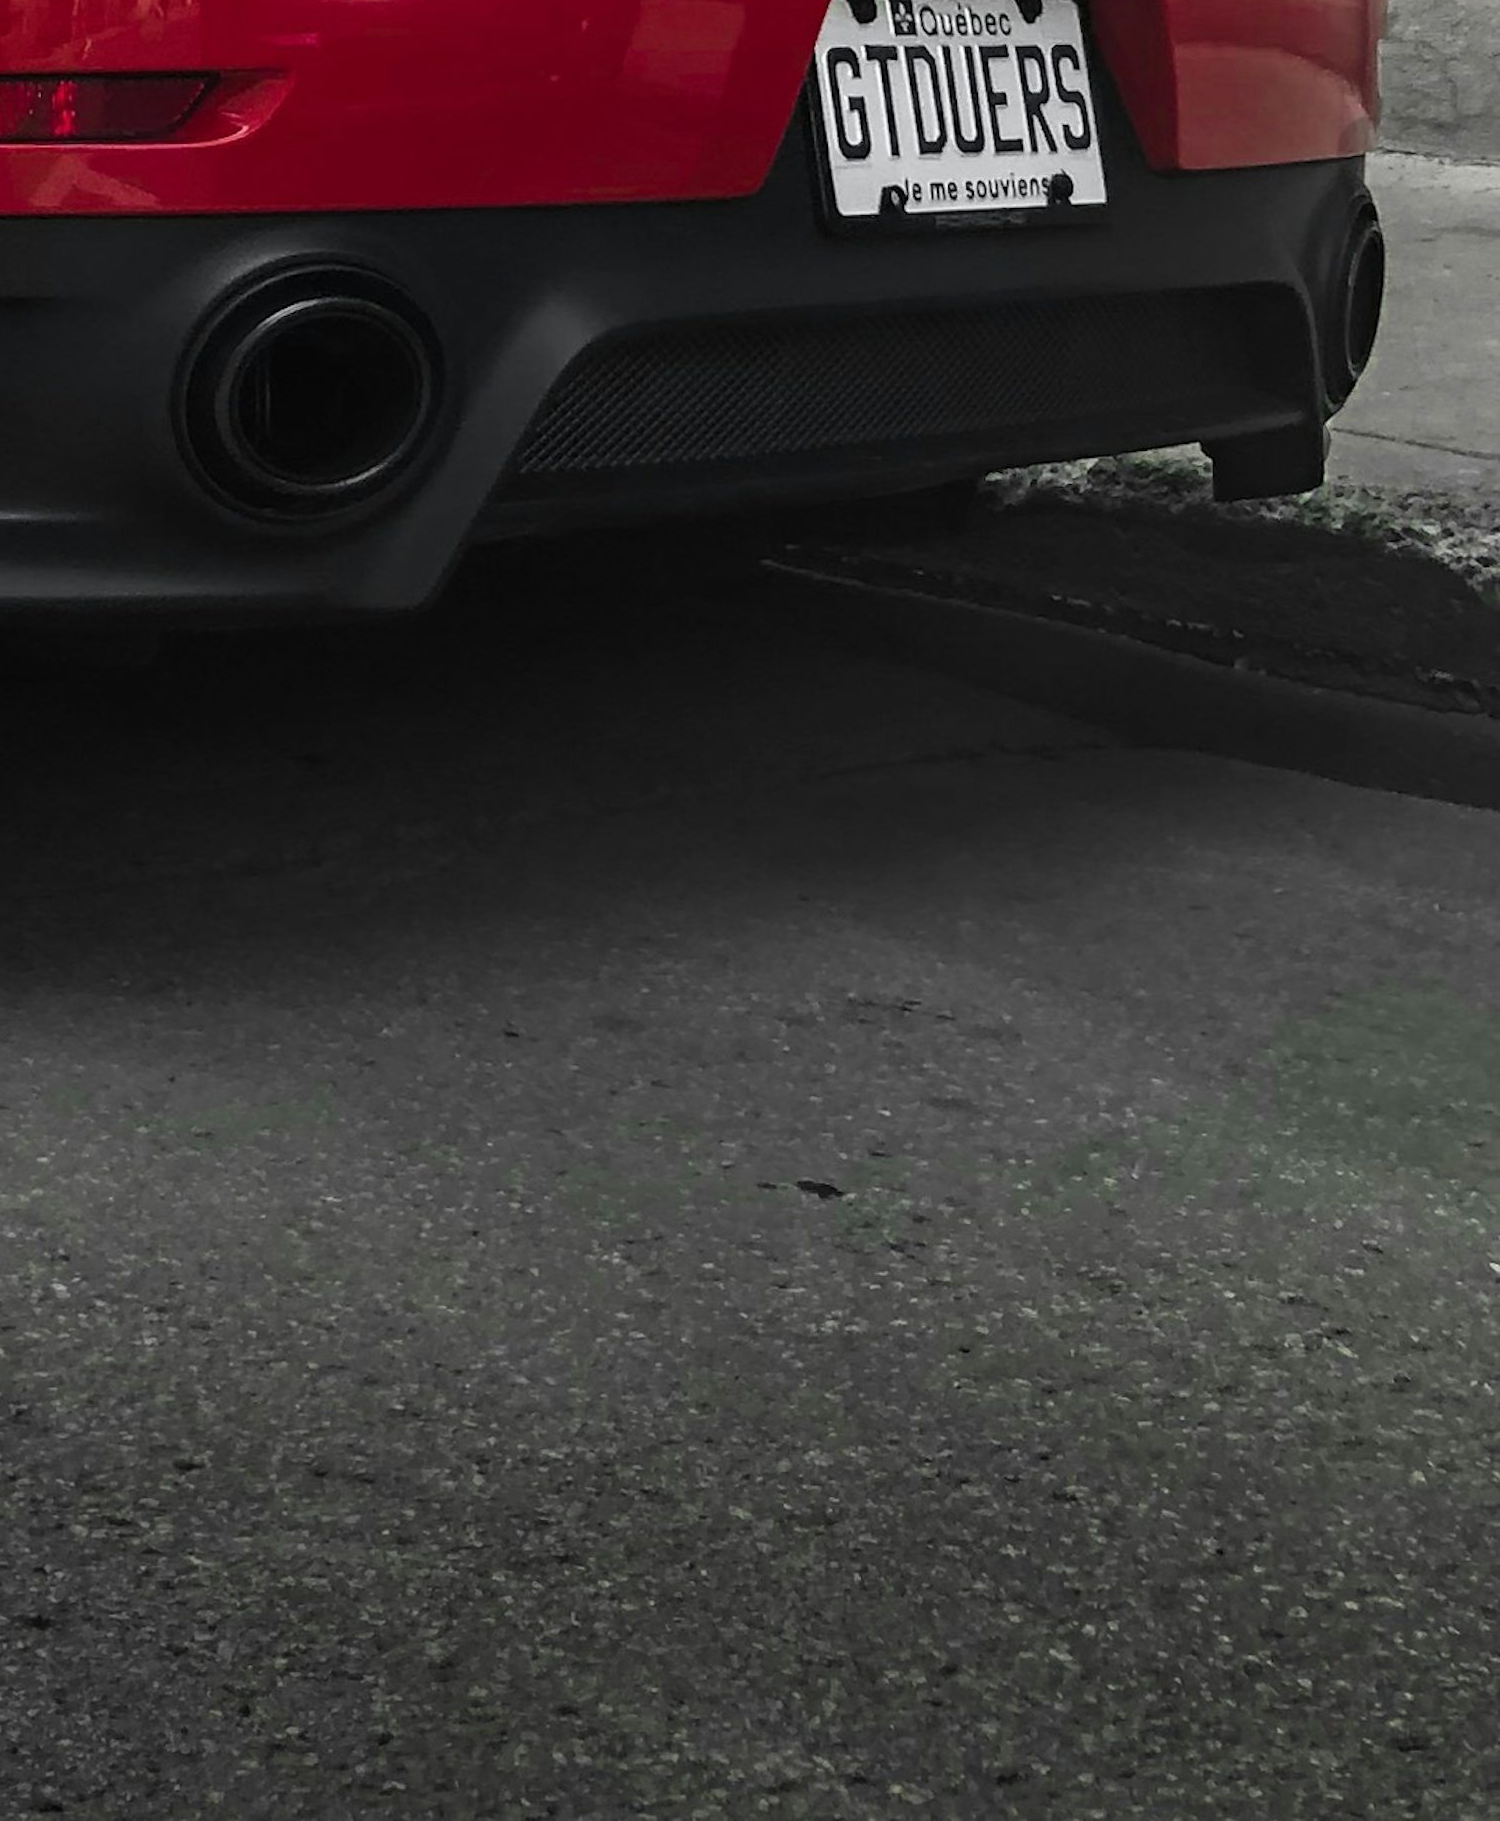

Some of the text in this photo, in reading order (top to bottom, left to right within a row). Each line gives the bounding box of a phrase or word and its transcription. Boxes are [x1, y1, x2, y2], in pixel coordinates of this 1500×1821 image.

[918, 4, 1012, 36] Québec
[825, 44, 1092, 161] GTDUERS
[930, 181, 958, 201] me
[965, 172, 1050, 200] souviens
